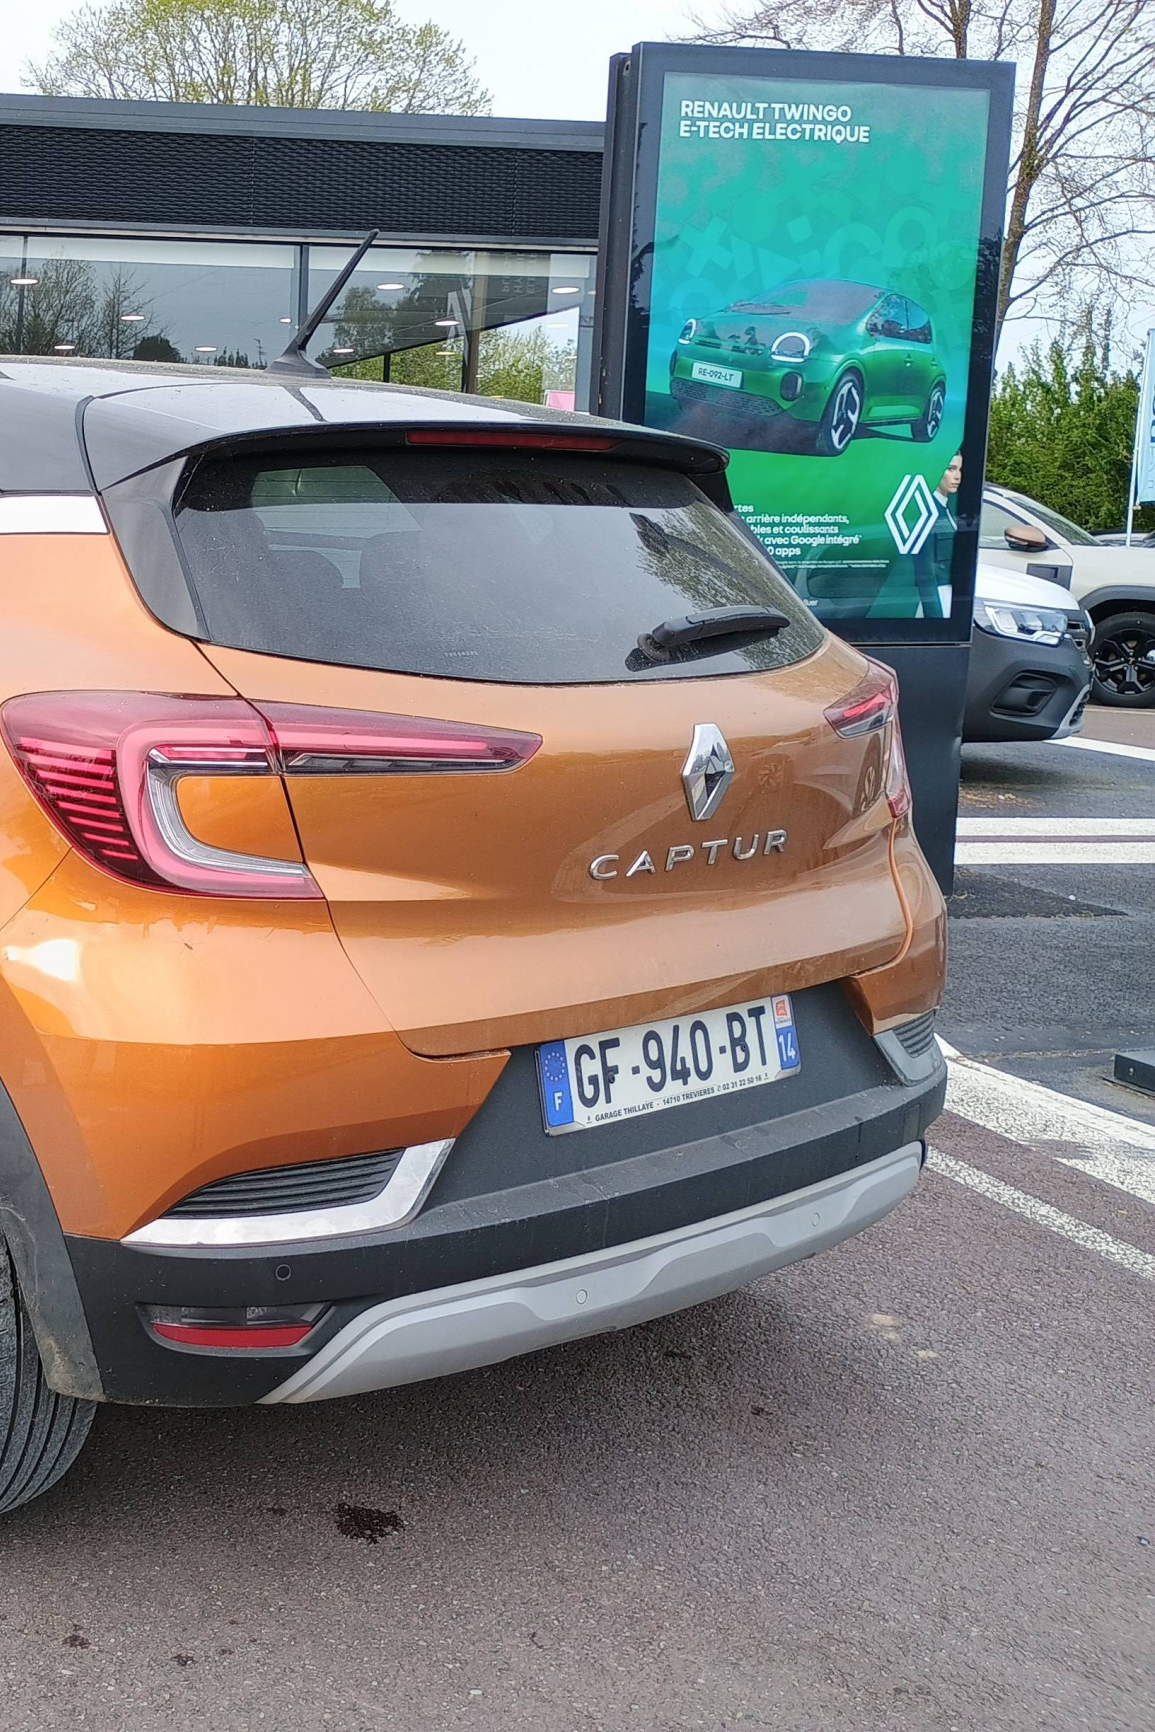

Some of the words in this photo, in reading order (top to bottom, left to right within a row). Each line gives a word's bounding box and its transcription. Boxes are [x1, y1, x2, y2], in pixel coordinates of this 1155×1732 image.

[680, 100, 768, 119] RENAULT
[770, 103, 852, 122] TWINGO
[679, 120, 748, 139] E-TECH
[752, 122, 870, 144] ELECTRIQUE
[746, 513, 781, 523] arrière
[781, 513, 850, 526] indépendants,
[772, 525, 784, 534] et
[784, 524, 839, 534] coulissants
[764, 536, 790, 545] avec
[790, 534, 825, 547] Google
[775, 547, 802, 558] apps
[589, 829, 789, 881] CAPTUR
[574, 1005, 767, 1109] GF-940-BT
[779, 1032, 796, 1062] 14
[553, 1091, 563, 1112] F
[594, 1108, 623, 1122] GARAGE
[623, 1101, 654, 1115] THILLAYE
[682, 1086, 715, 1101] TREVIERES
[722, 1082, 730, 1091] 02
